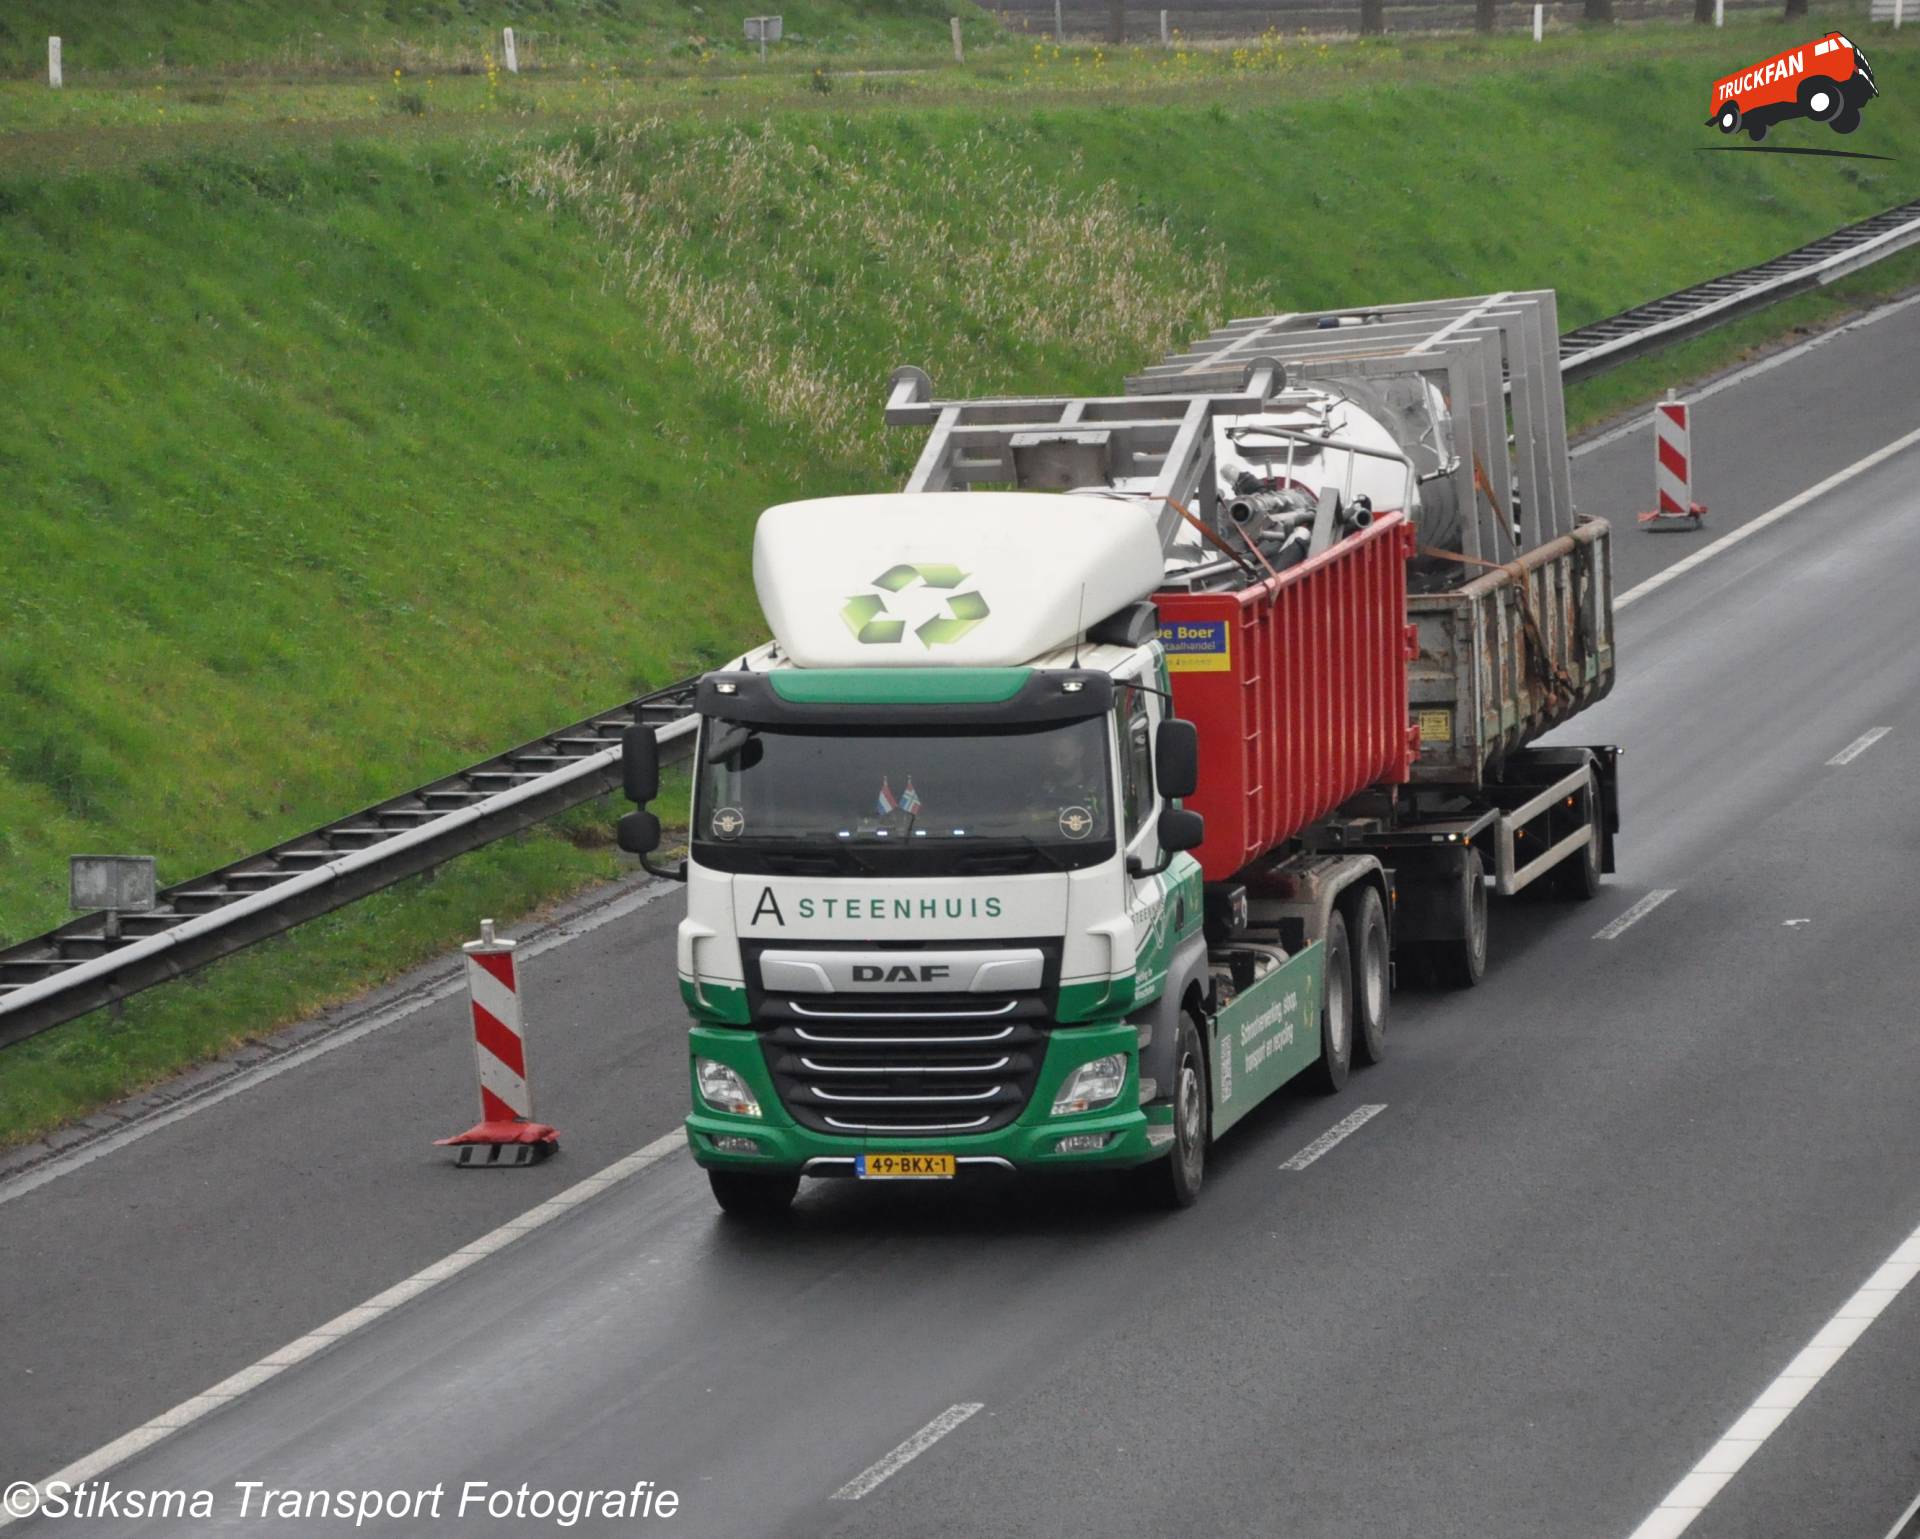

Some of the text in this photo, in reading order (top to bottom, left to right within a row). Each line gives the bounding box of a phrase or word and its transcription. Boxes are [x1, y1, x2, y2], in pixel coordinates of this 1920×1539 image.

[1178, 627, 1215, 639] Boer
[751, 886, 1002, 926] A STEENHUIS
[852, 965, 949, 982] DAF
[872, 1157, 946, 1173] 49-BKX-1
